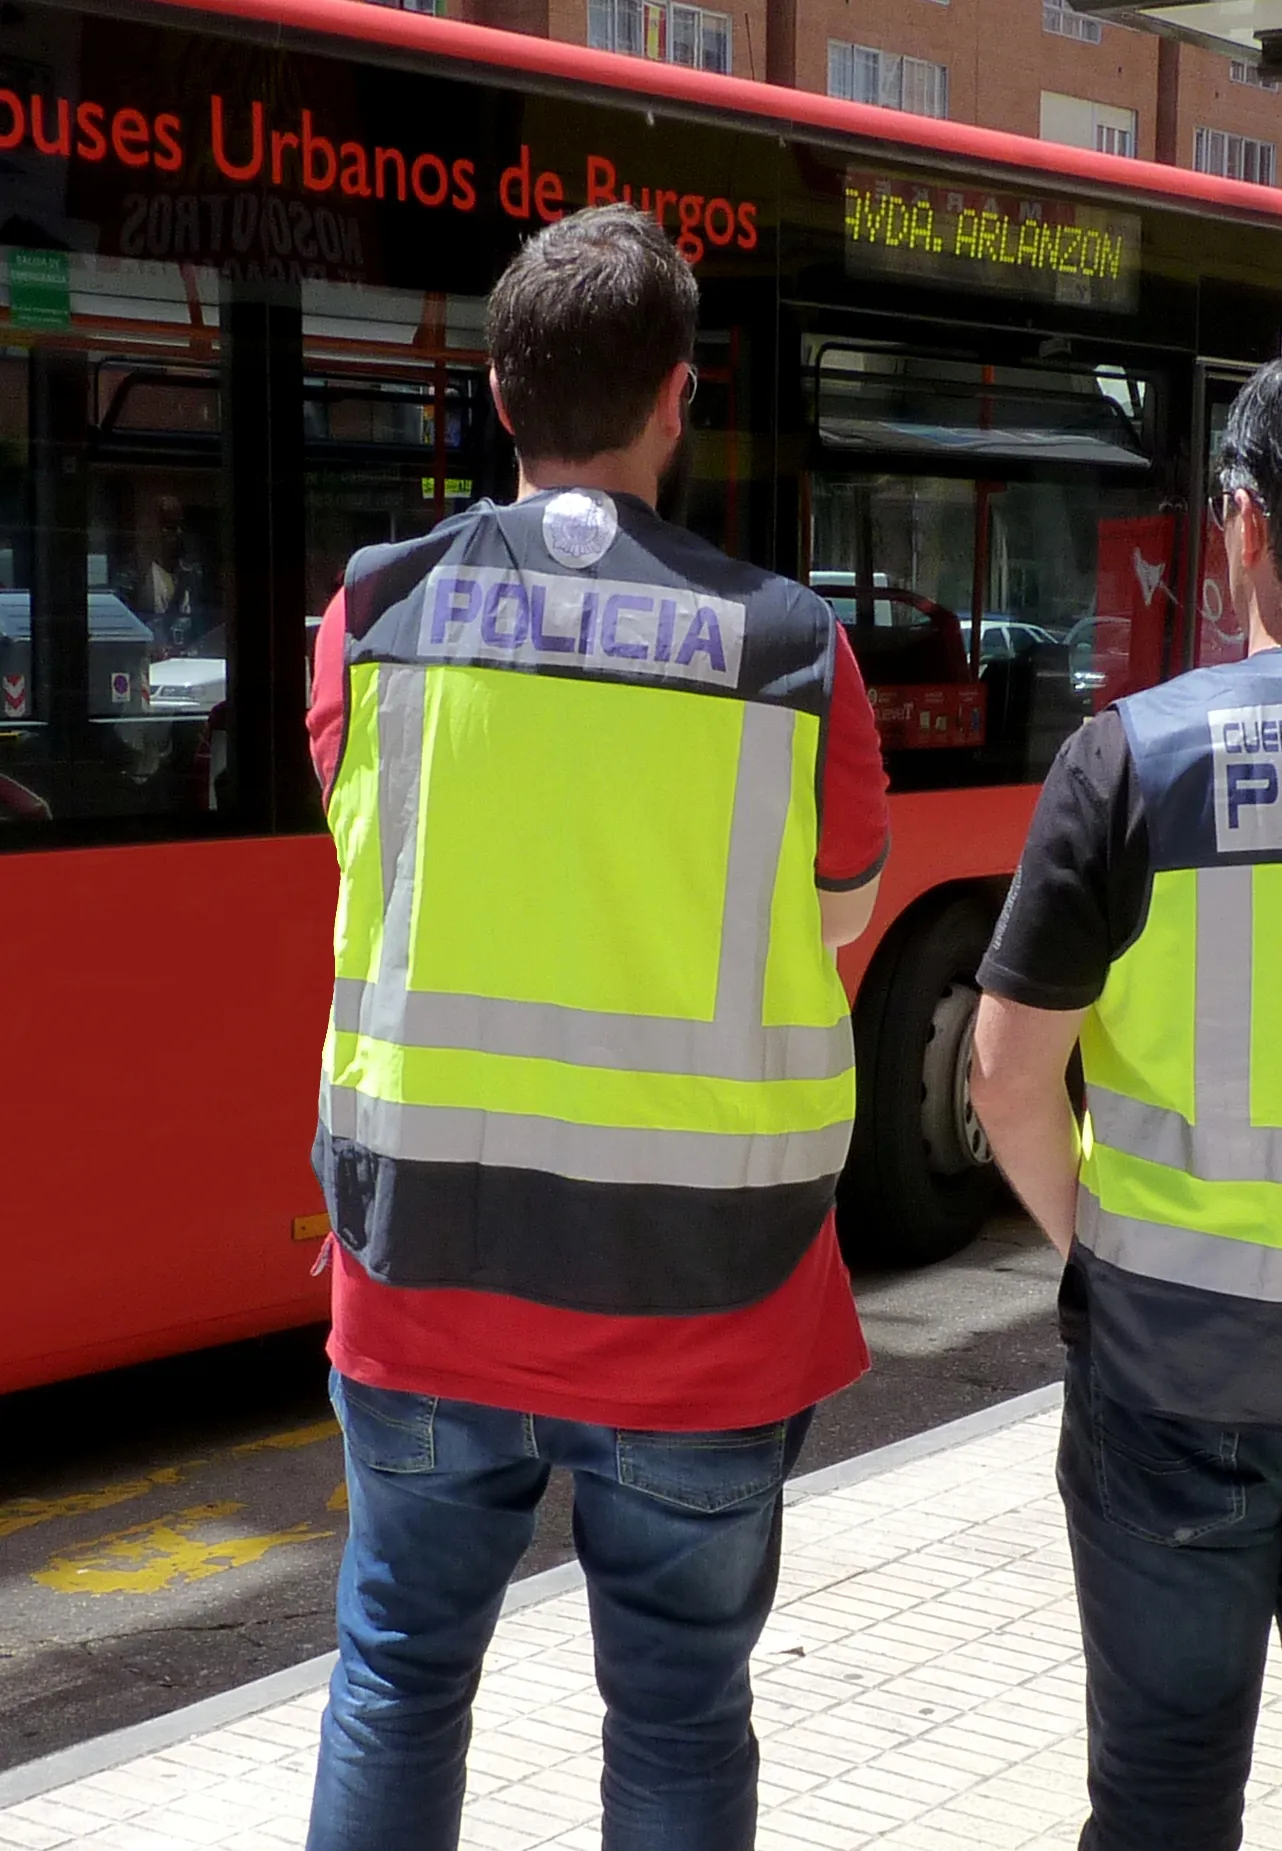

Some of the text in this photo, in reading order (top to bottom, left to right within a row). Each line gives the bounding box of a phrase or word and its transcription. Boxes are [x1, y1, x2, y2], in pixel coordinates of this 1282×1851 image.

[211, 94, 477, 212] Urbanos
[500, 144, 564, 222] de
[954, 207, 1124, 280] ARLANZON
[429, 578, 727, 674] POLICIA
